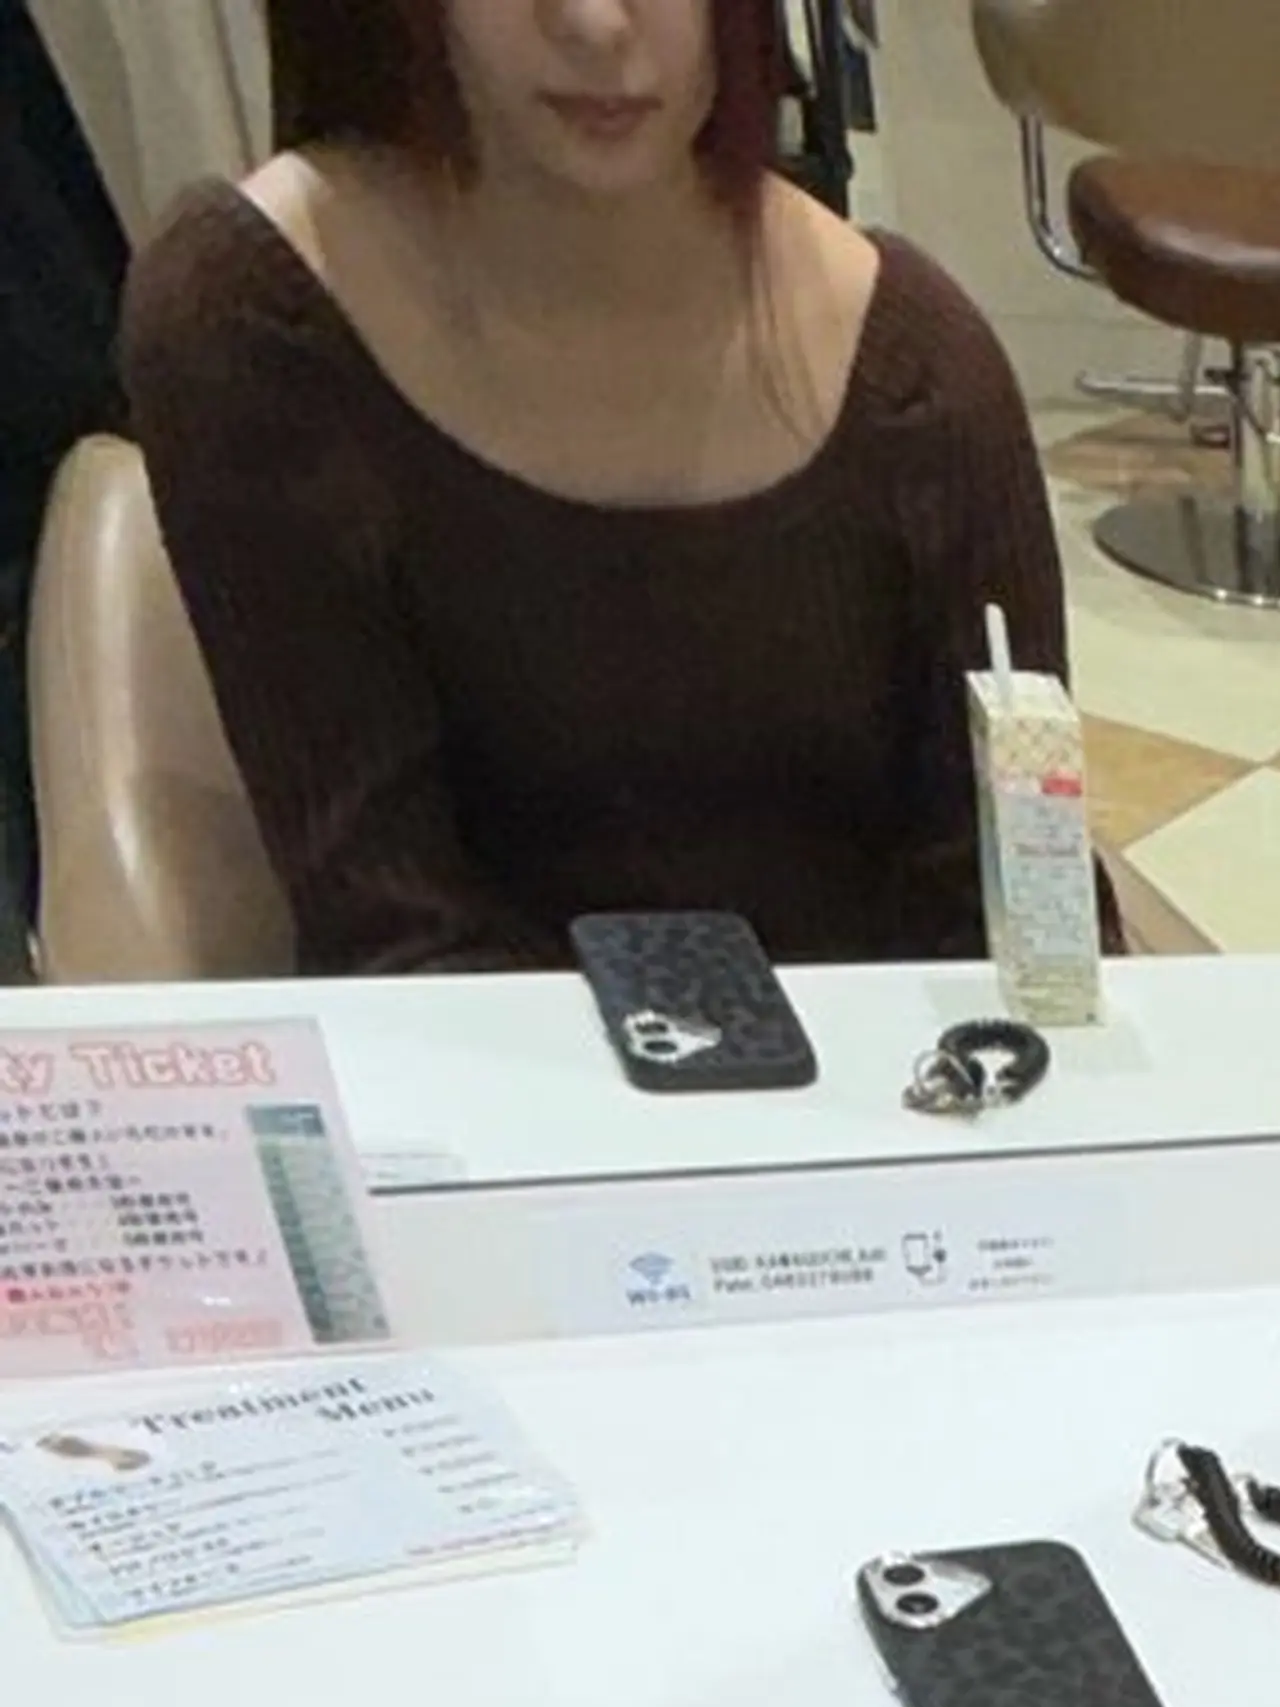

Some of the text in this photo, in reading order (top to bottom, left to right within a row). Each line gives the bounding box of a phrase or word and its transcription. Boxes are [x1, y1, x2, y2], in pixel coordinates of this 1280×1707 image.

[68, 1039, 276, 1088] Ticket
[129, 1376, 369, 1435] Treatment
[315, 1386, 436, 1422] Menu
